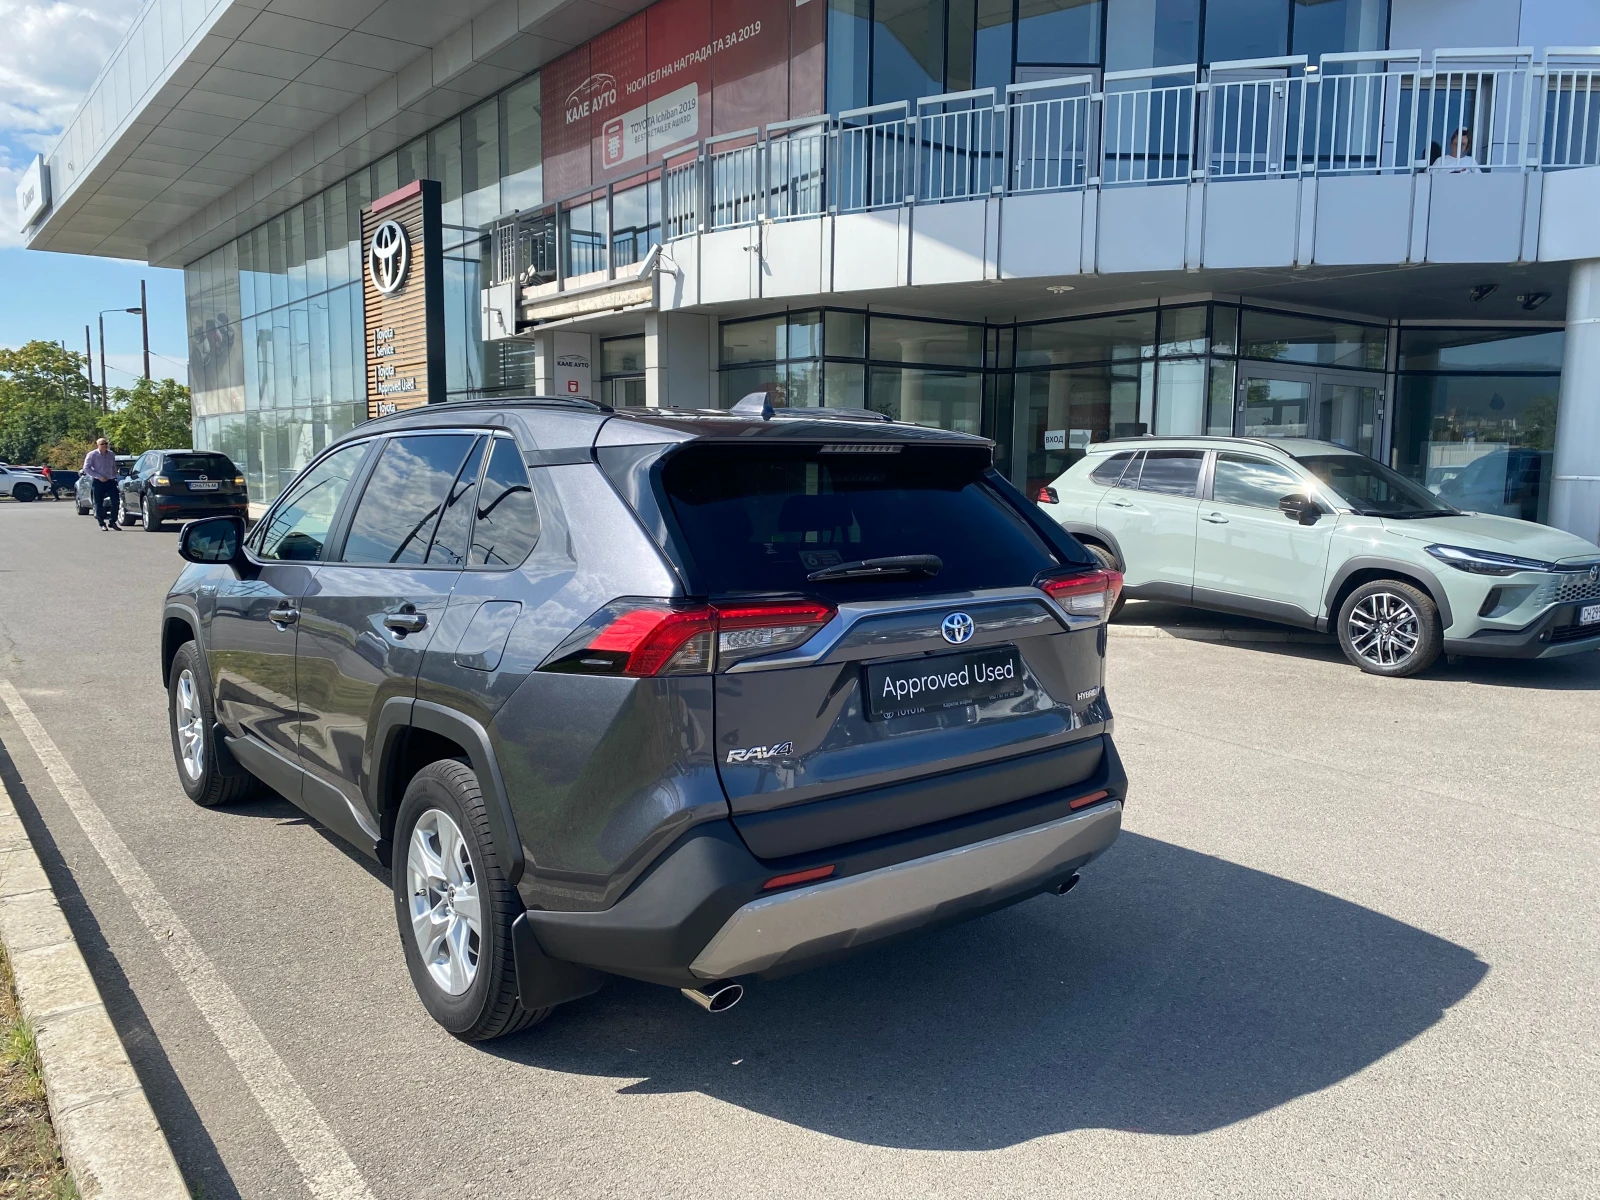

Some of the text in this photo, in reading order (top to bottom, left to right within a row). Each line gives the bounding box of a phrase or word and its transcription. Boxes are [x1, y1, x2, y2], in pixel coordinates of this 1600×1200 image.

[627, 69, 661, 95] НОСИТЕЛ
[662, 63, 673, 78] НА
[725, 32, 737, 48] ЗА
[738, 20, 761, 42] 2019
[566, 88, 617, 125] КАЛЕ АУТО
[630, 98, 696, 135] TOYOTA Ichiban 2019
[634, 114, 692, 144] BEST RETAILER AWARD
[376, 328, 394, 341] Toyota
[376, 345, 394, 357] Service
[377, 365, 395, 378] Toyota
[378, 378, 415, 394] Approved Used
[378, 401, 396, 414] Toyota
[1045, 435, 1064, 444] ВХОД
[882, 658, 1015, 701] Approved Used
[726, 741, 794, 763] RAV4
